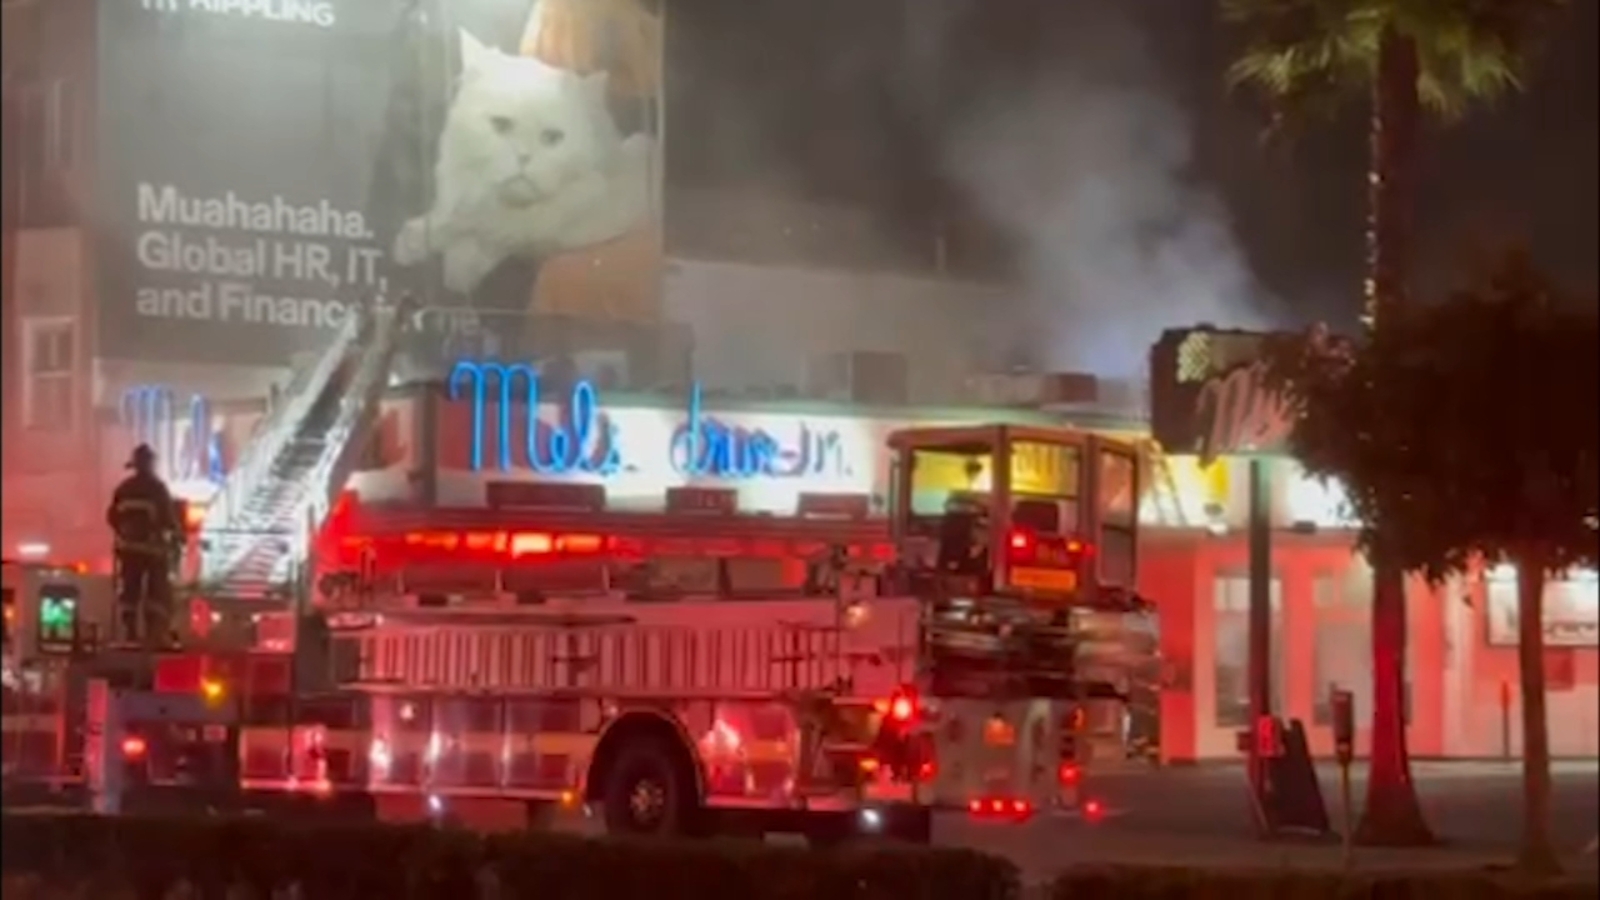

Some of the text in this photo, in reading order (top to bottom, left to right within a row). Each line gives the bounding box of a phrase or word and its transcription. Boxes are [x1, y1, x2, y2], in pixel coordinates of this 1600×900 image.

[137, 183, 374, 239] Muahahaha.
[136, 230, 388, 293] Global HR, IT,
[136, 281, 212, 320] and
